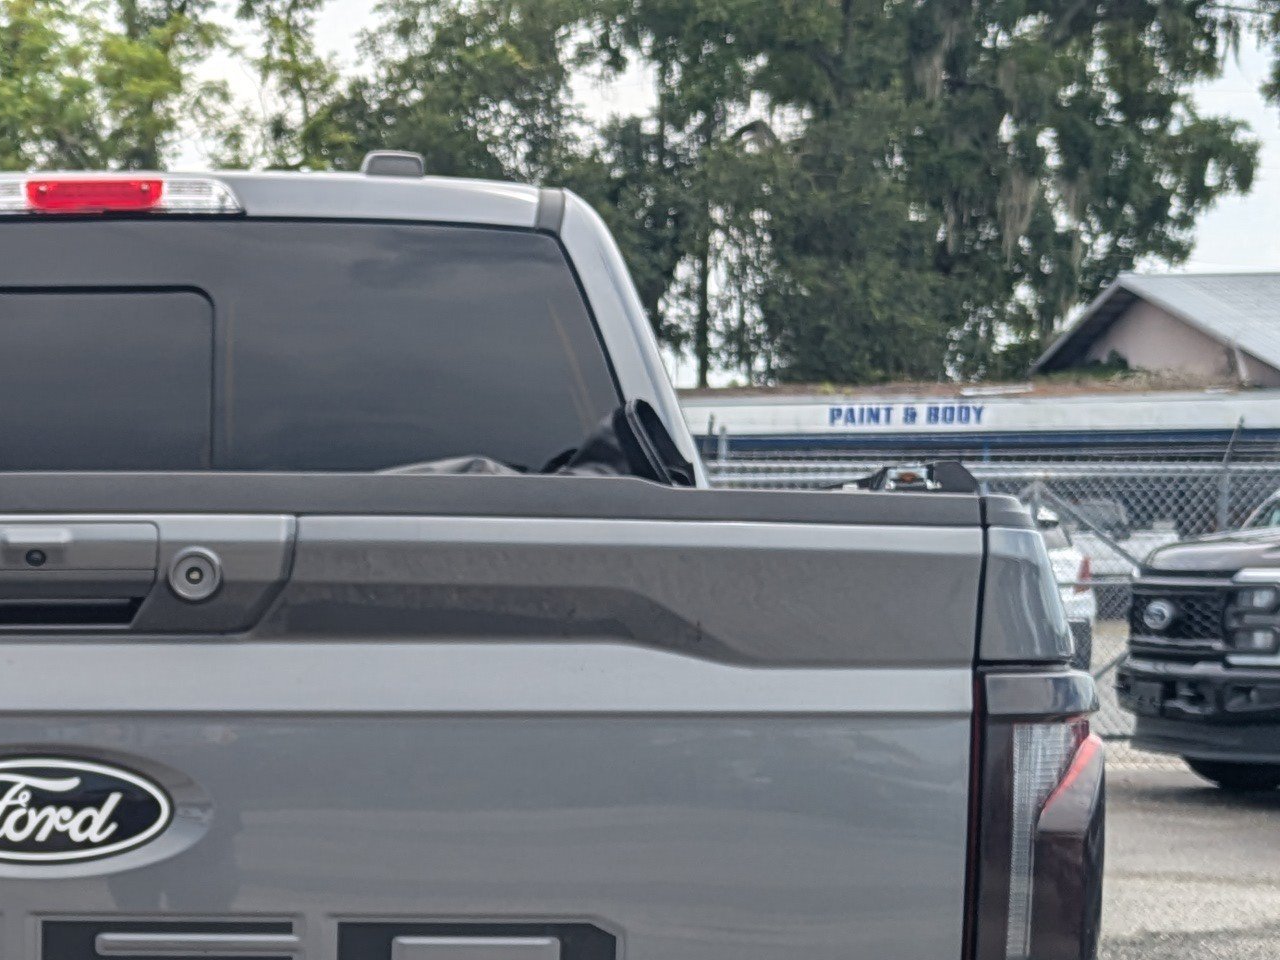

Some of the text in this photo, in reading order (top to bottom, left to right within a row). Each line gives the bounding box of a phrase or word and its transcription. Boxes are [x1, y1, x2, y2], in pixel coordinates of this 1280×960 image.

[829, 405, 984, 425] PAINT & BODY
